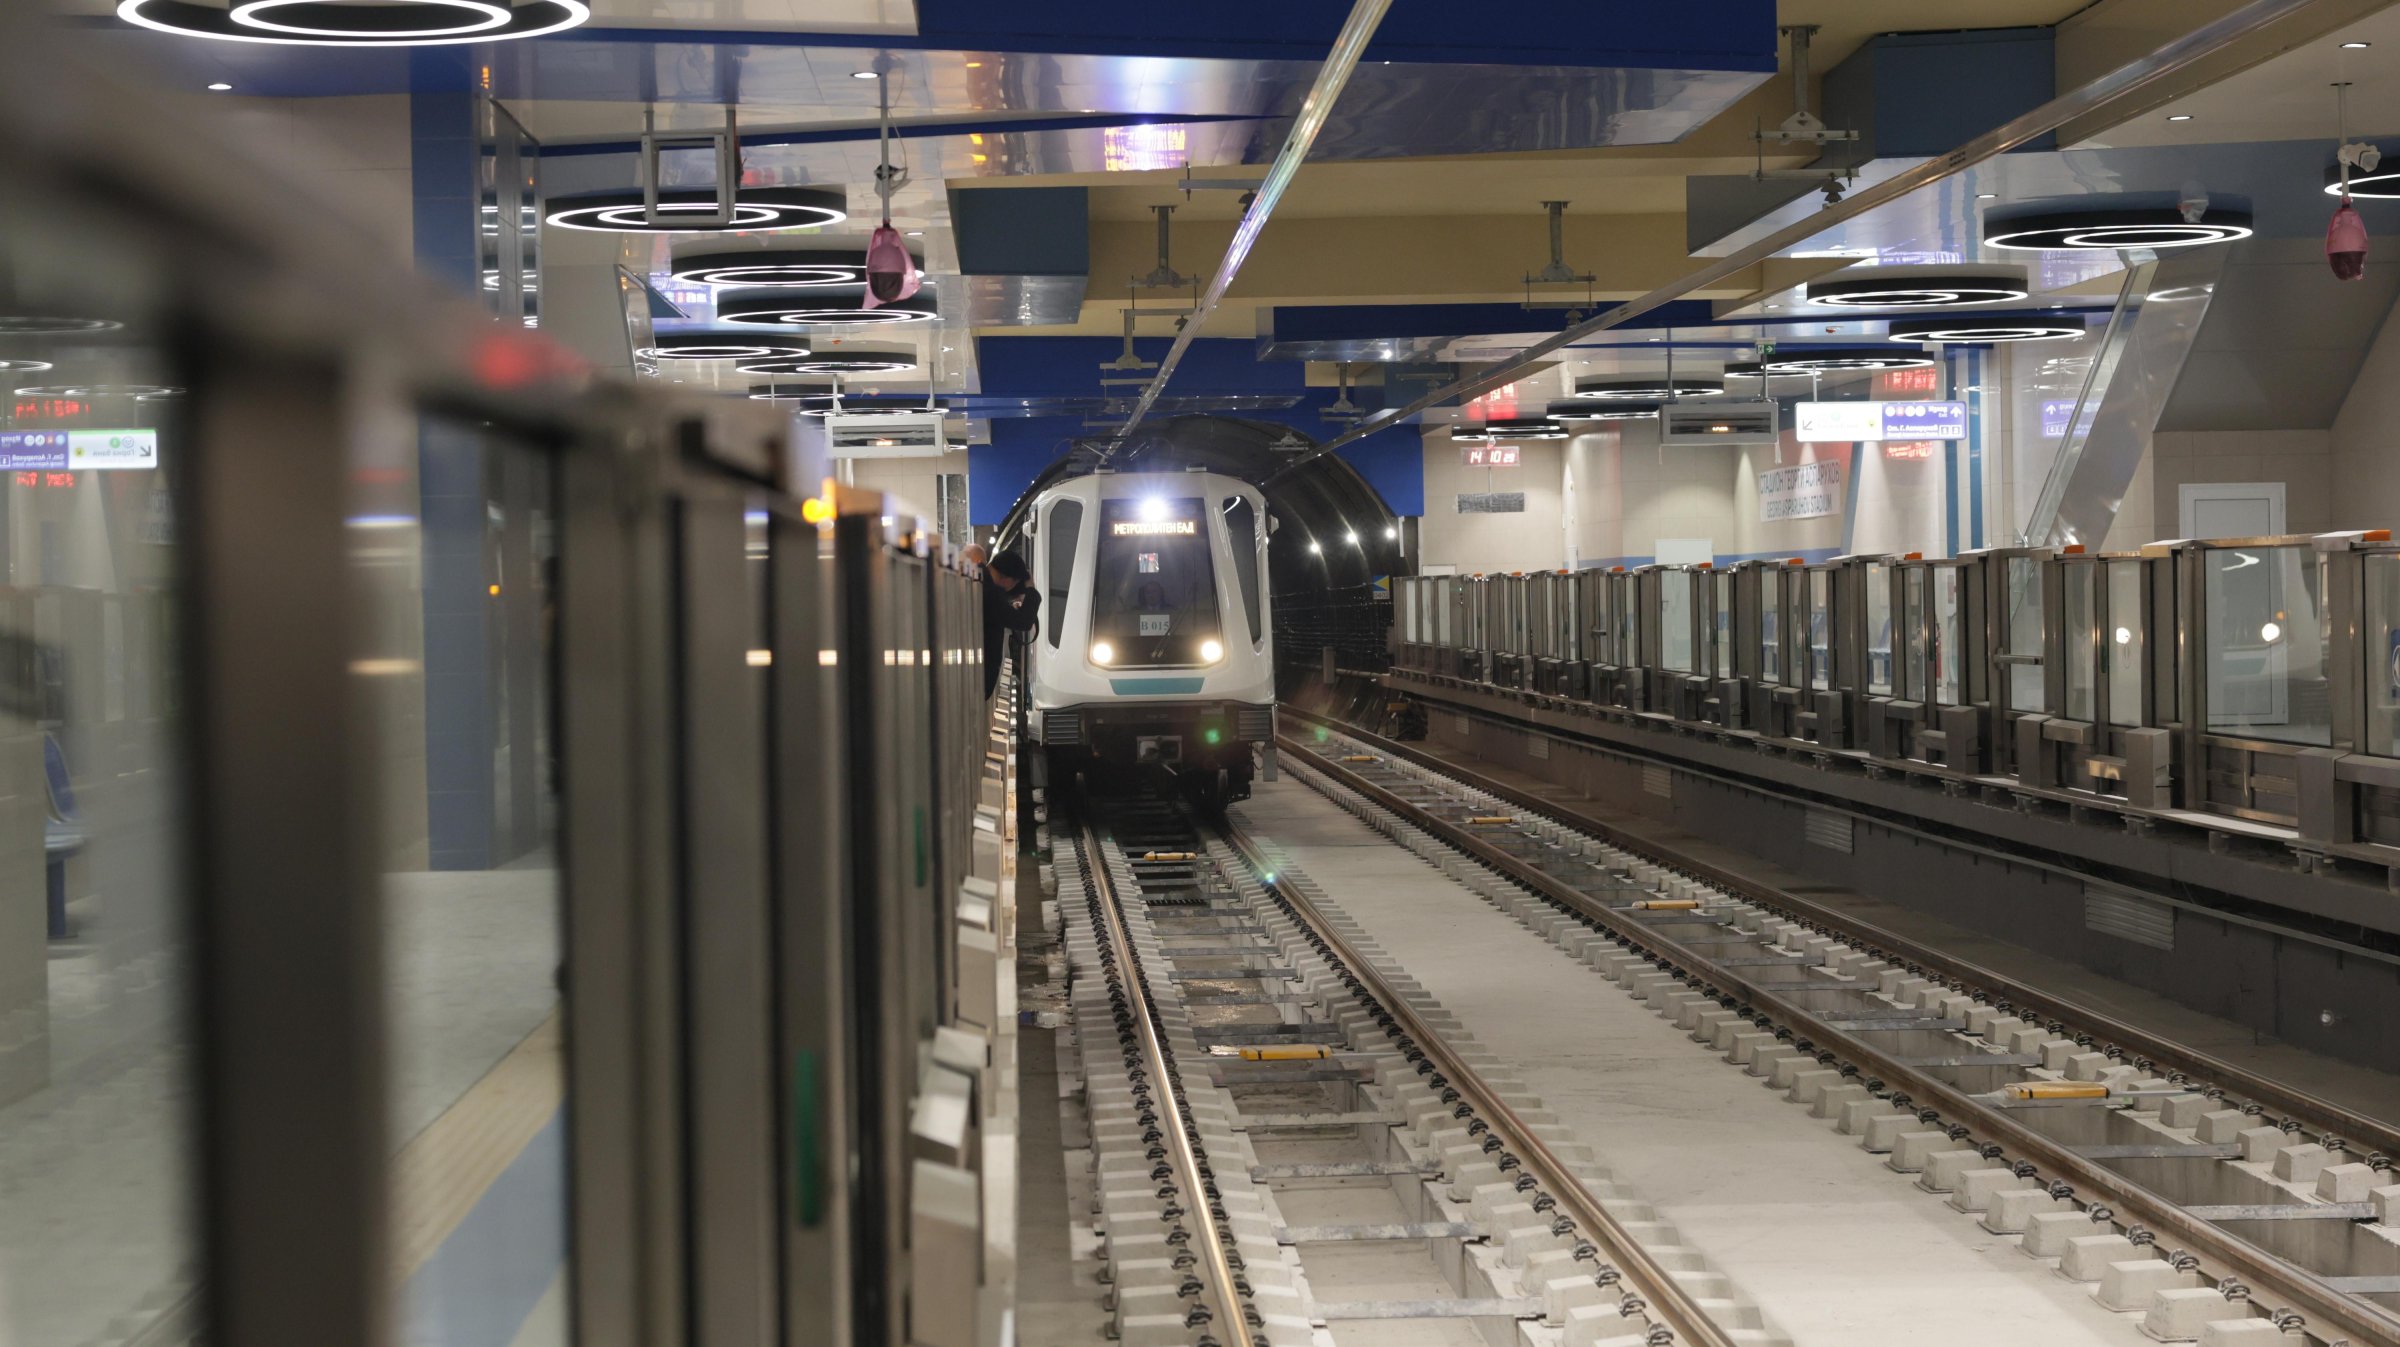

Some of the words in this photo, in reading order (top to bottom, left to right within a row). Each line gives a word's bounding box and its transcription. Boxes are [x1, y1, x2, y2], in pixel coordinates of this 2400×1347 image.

[1470, 451, 1482, 463] 14
[1490, 450, 1502, 463] 10
[1151, 621, 1169, 630] 015
